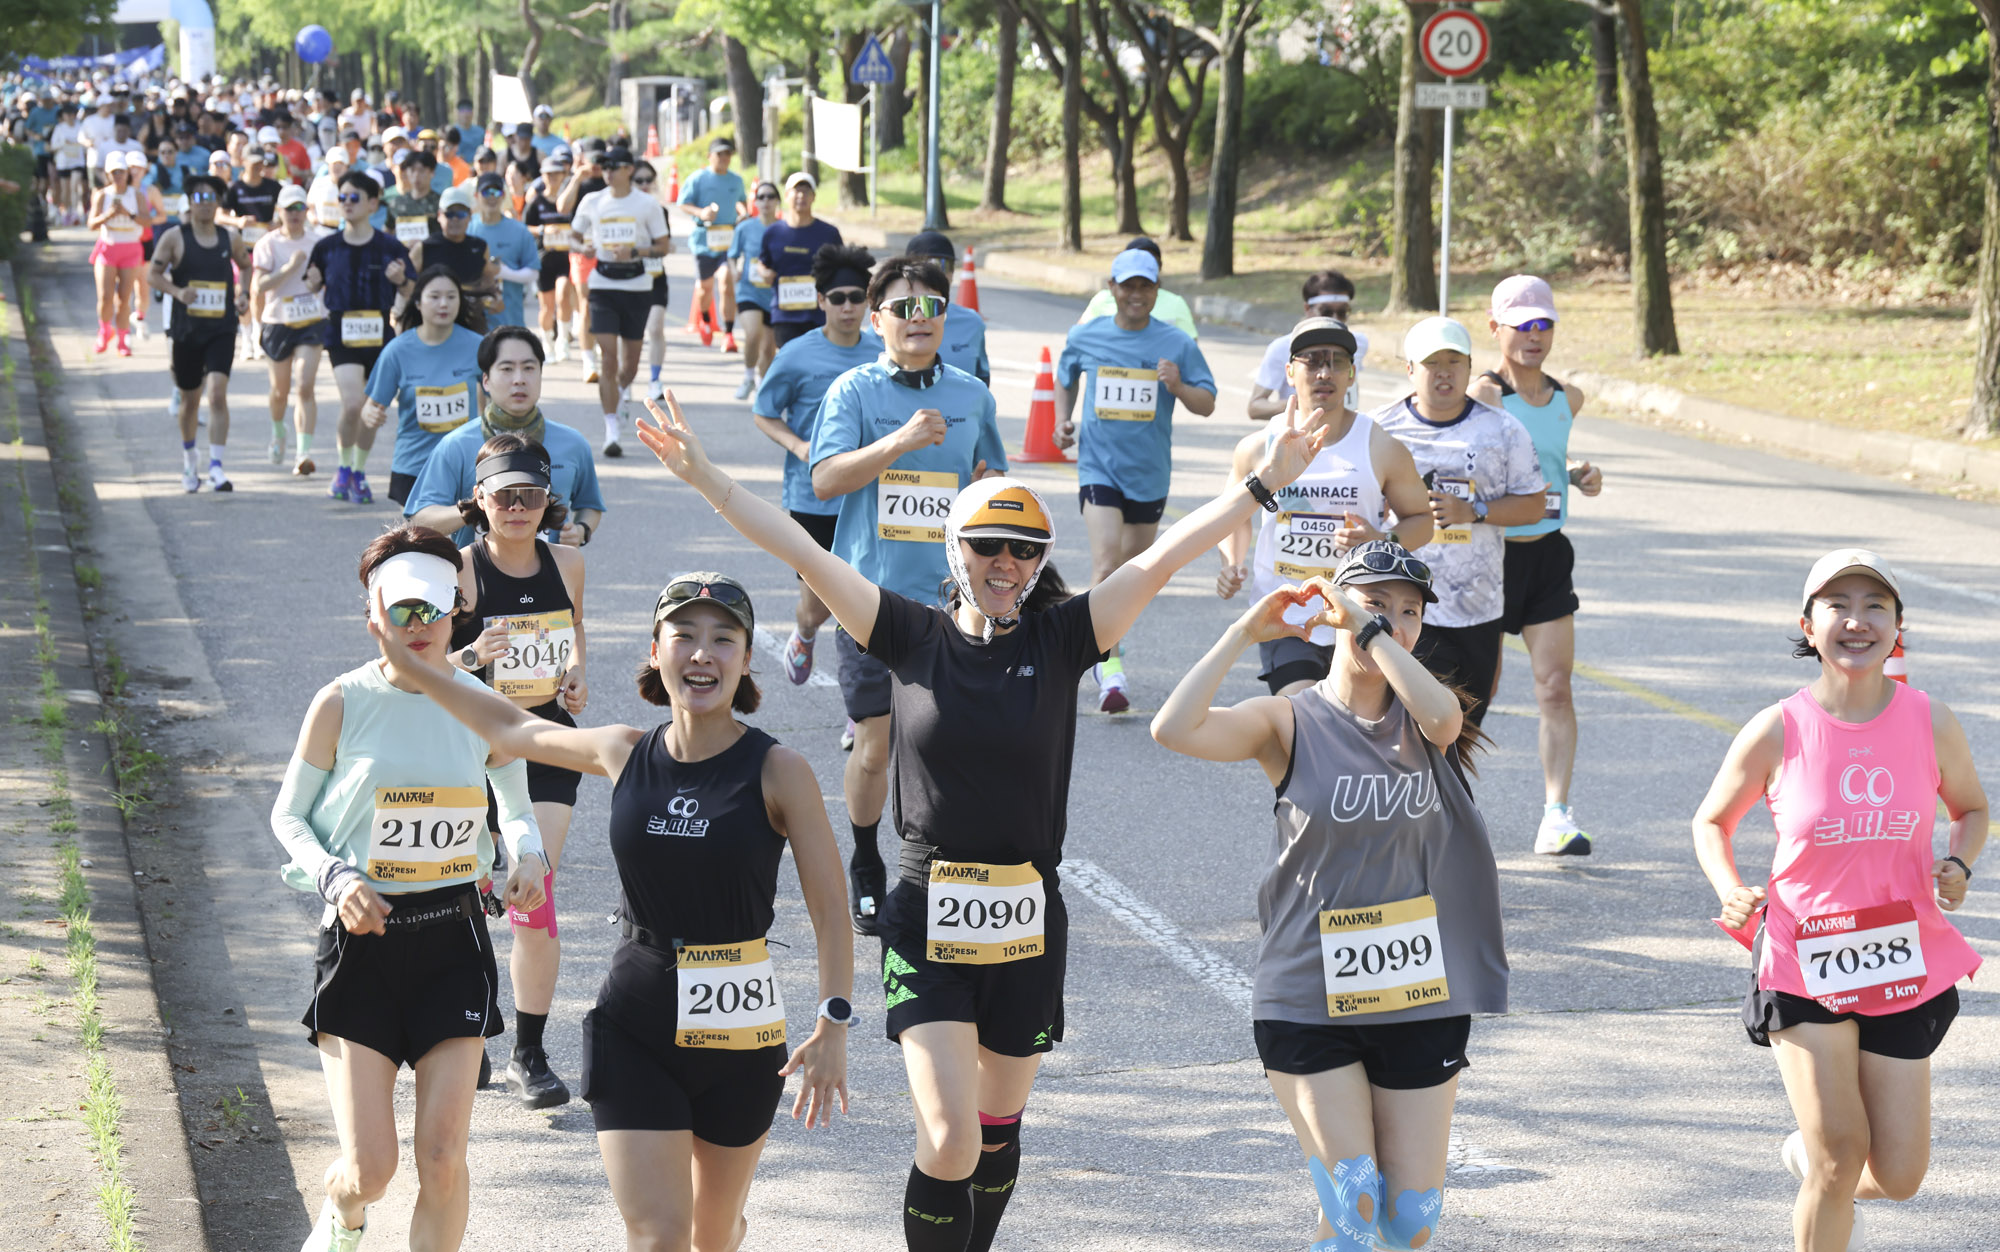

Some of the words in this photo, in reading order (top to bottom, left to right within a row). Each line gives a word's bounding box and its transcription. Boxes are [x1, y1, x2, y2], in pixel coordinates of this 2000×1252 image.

[1438, 30, 1472, 57] 20
[1103, 385, 1152, 403] 1115
[421, 399, 465, 417] 2118
[1275, 487, 1359, 498] UMANRACE
[885, 494, 951, 519] 7068
[927, 531, 937, 539] 10
[1301, 521, 1336, 532] 0450
[1443, 532, 1454, 540] 10
[1454, 532, 1467, 541] km
[519, 594, 534, 604] alo
[502, 639, 569, 669] 3046
[383, 792, 434, 804] 시사저널
[379, 819, 474, 849] 2102
[440, 865, 451, 875] 10
[453, 862, 472, 873] km
[937, 866, 989, 882] 시사저널
[937, 896, 1036, 930] 2090
[1327, 910, 1382, 927] 시사저널
[686, 948, 742, 962] 시사저널
[1003, 945, 1017, 957] 10
[1018, 943, 1038, 955] km
[1334, 934, 1433, 978] 2099
[1810, 936, 1912, 980] 7038
[688, 975, 777, 1015] 2081
[1405, 989, 1420, 1002] 10
[1422, 986, 1442, 999] km
[1884, 987, 1894, 1000] 5
[1895, 983, 1919, 998] km
[756, 1031, 770, 1043] 10
[771, 1028, 782, 1040] km
[907, 1206, 954, 1225] cep
